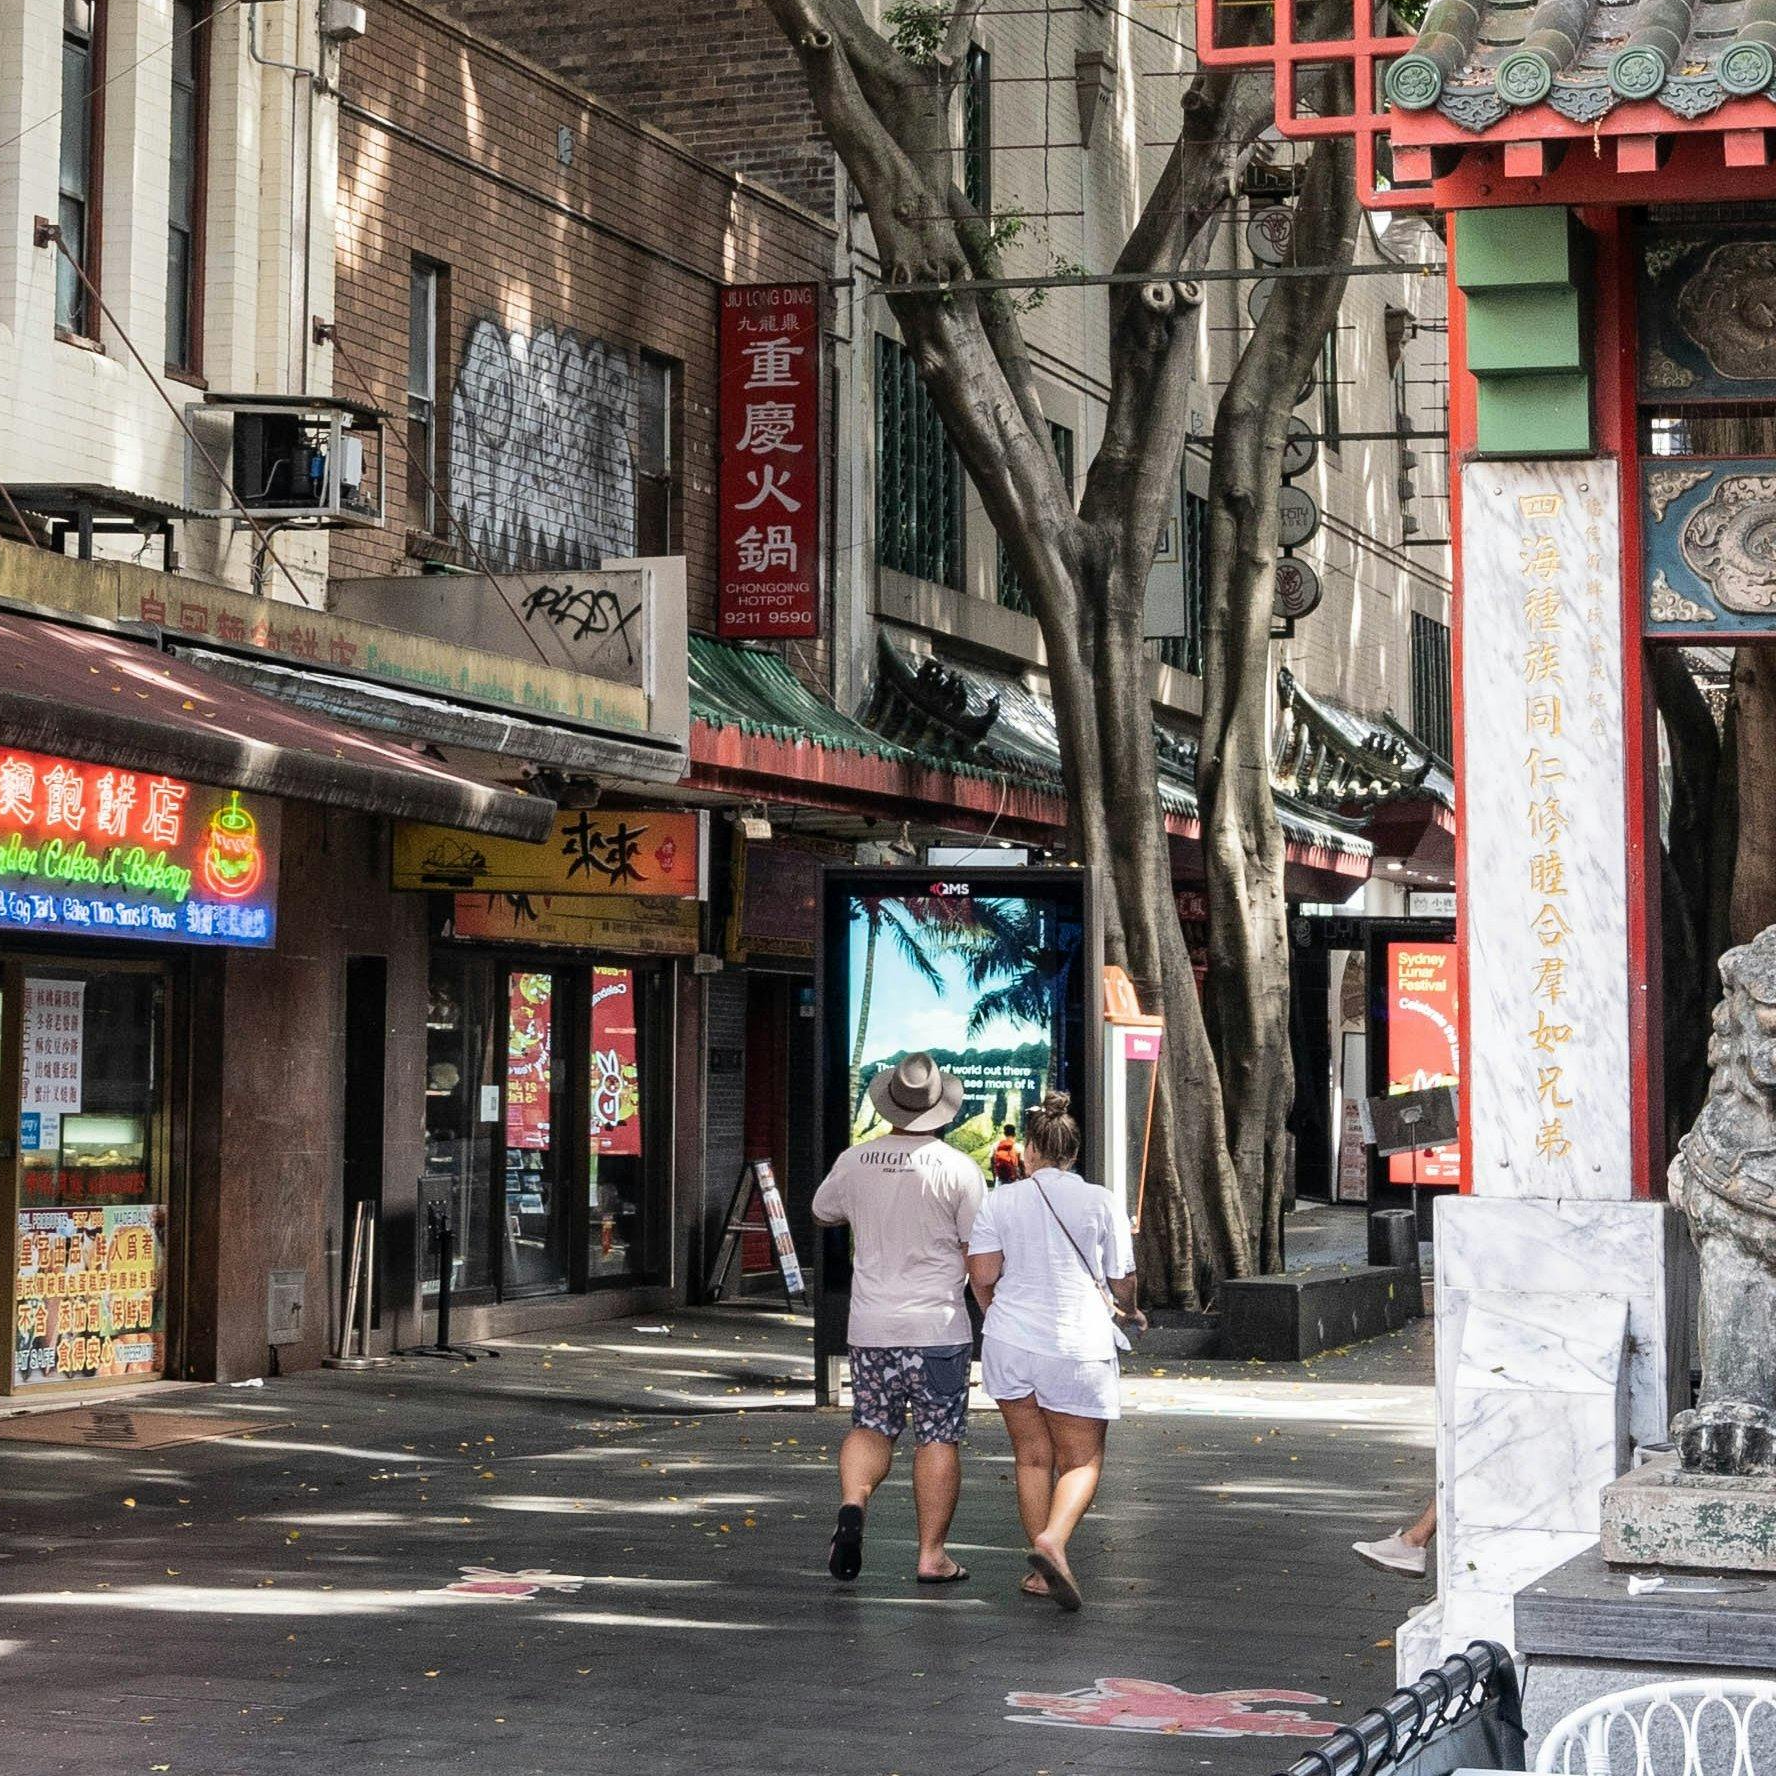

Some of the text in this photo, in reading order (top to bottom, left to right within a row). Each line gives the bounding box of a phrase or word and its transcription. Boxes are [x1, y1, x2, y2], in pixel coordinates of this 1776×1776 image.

[725, 287, 812, 307] JIU LONG DING
[737, 313, 801, 332] 九龍鼎
[735, 336, 805, 574] 重慶火鍋
[725, 582, 810, 595] CHONGQING
[737, 595, 795, 607] HOTPOT
[724, 610, 812, 624] 9211 9590
[44, 835, 101, 885] Cakes
[122, 845, 193, 903] Bakery
[1398, 952, 1446, 969] Sydney
[1398, 965, 1435, 978] Lunar
[1398, 978, 1447, 992] Festival
[953, 1063, 982, 1075] world
[983, 1065, 1002, 1076] out
[1003, 1065, 1031, 1076] there
[964, 1079, 1036, 1090] see more of it
